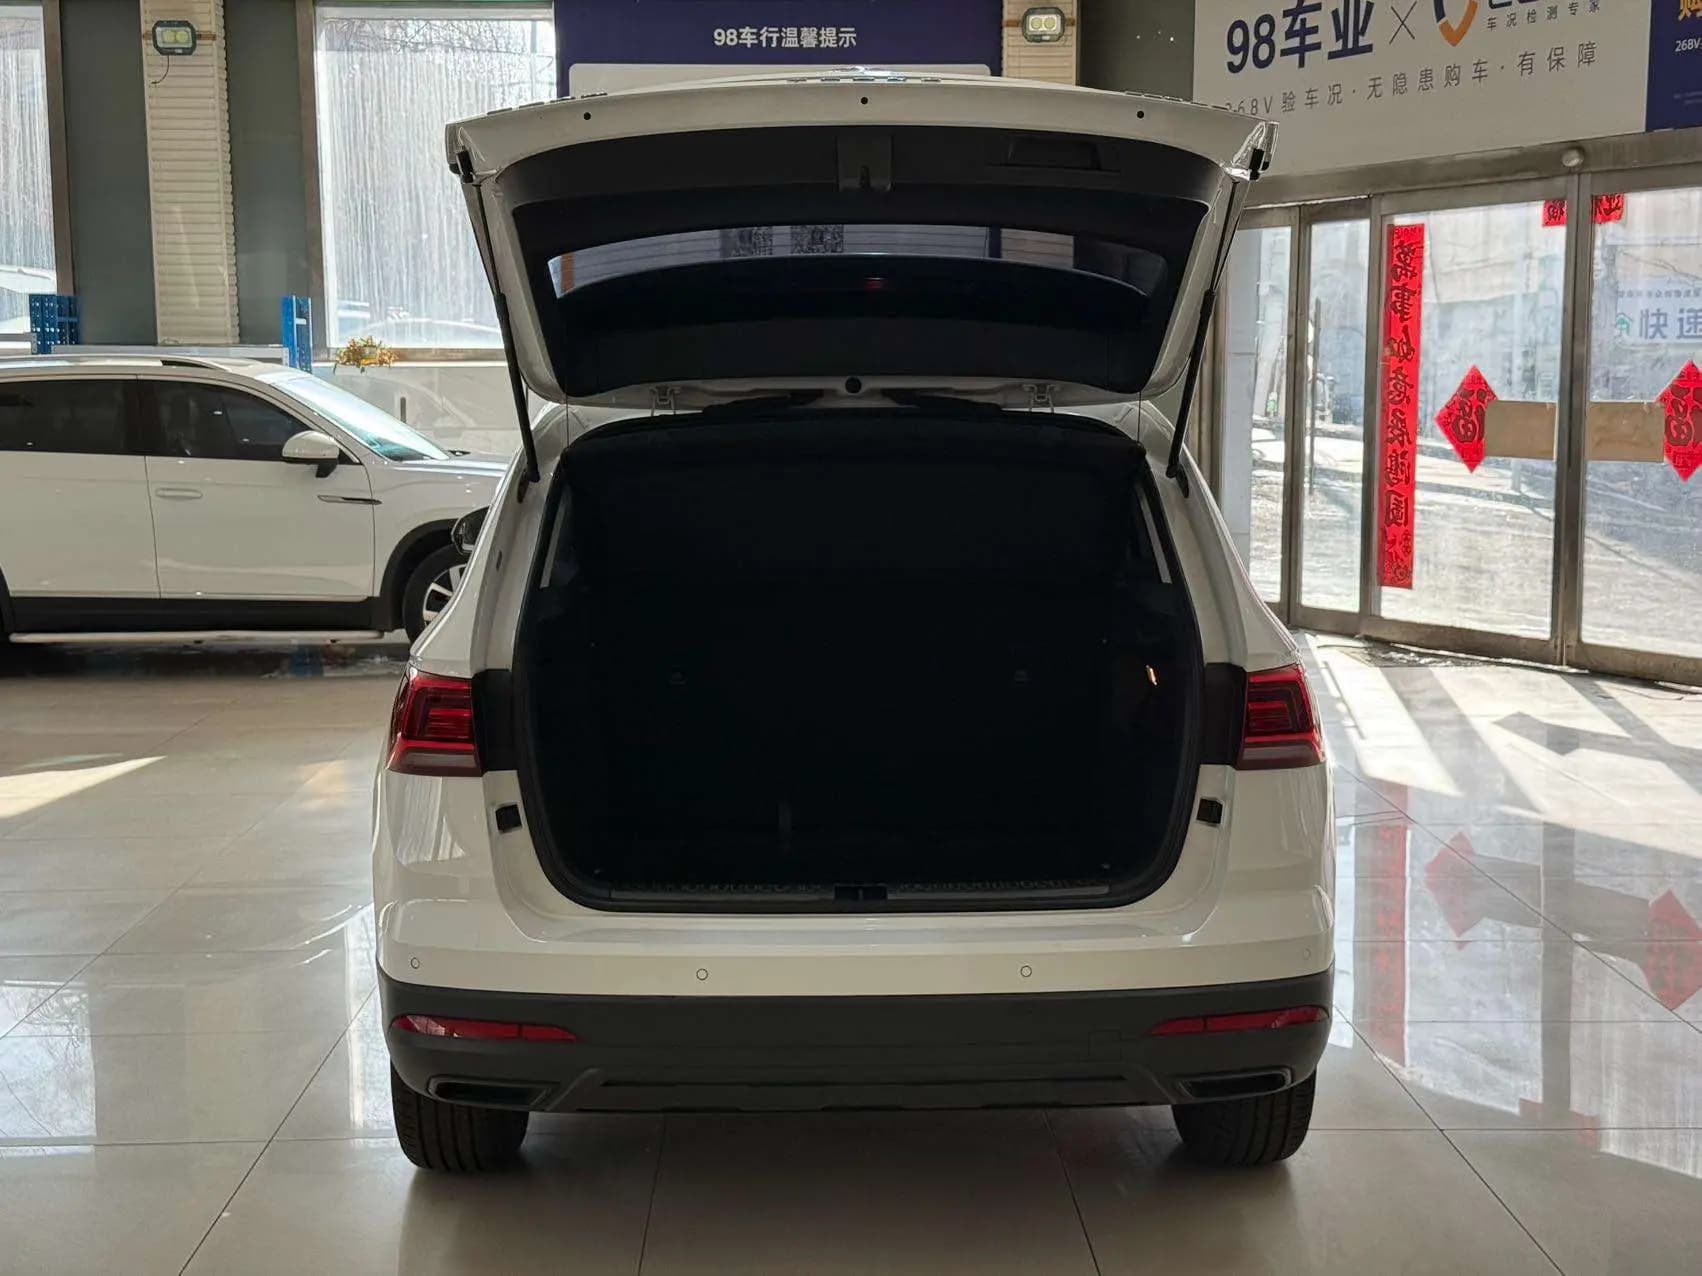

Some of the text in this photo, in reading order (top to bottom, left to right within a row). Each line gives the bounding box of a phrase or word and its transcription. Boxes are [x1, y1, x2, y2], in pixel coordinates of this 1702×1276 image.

[712, 26, 857, 48] 98车行温馨提示
[1226, 0, 1375, 74] 98车业
